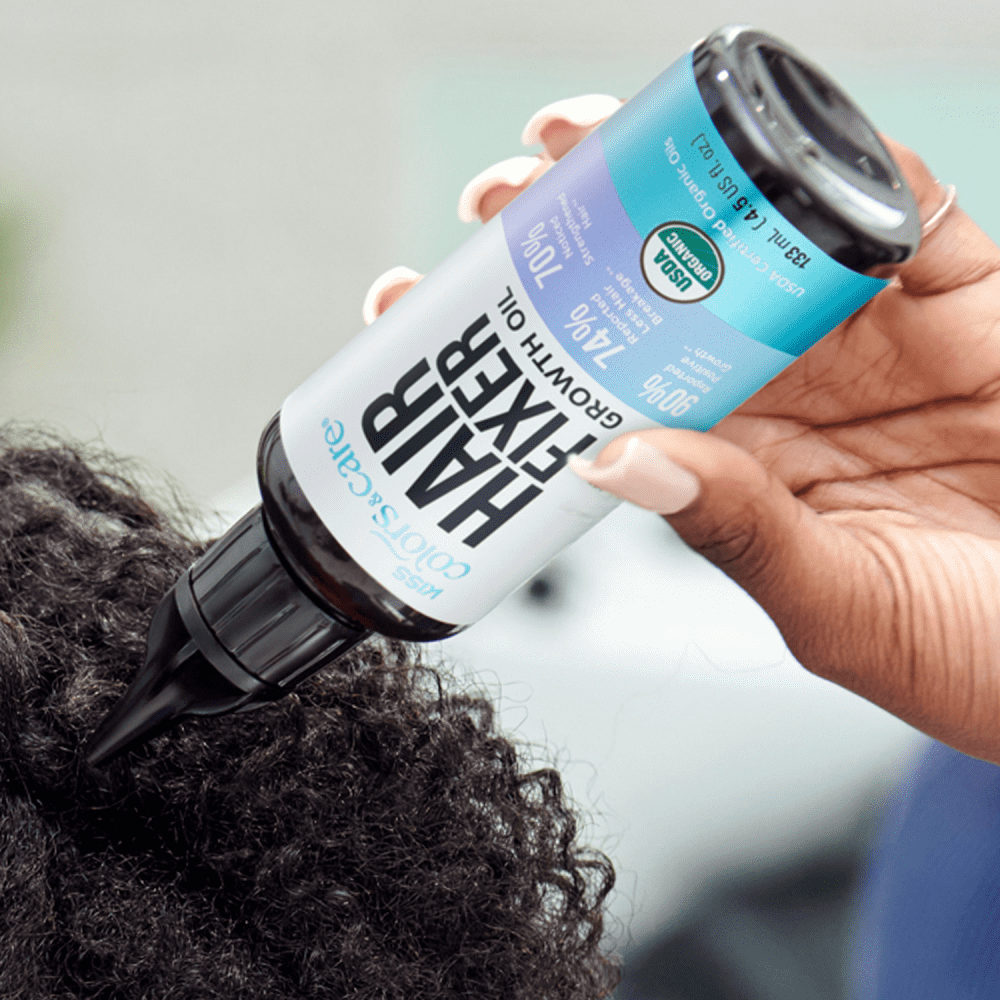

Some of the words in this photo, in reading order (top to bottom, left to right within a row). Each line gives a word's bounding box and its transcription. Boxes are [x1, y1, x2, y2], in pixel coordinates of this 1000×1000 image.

[664, 136, 681, 165] Oils
[708, 159, 725, 179] fl.
[676, 163, 716, 220] Organic
[717, 176, 739, 200] US
[521, 222, 563, 289] 70%
[550, 215, 574, 260] Noticed
[665, 232, 713, 282] ORGANIC
[711, 219, 769, 273] Certified
[766, 228, 791, 250] mL
[784, 246, 812, 269] 133
[653, 248, 693, 292] USDA
[769, 269, 805, 298] USDA
[497, 286, 526, 331] OIL
[590, 293, 639, 345] Reported
[603, 284, 626, 310] Hair
[563, 303, 626, 370] 74%
[625, 309, 650, 335] Less
[436, 313, 598, 484] FIXER
[520, 332, 623, 430] GROWTH
[638, 373, 699, 417] 90%
[361, 357, 544, 548] HAIR
